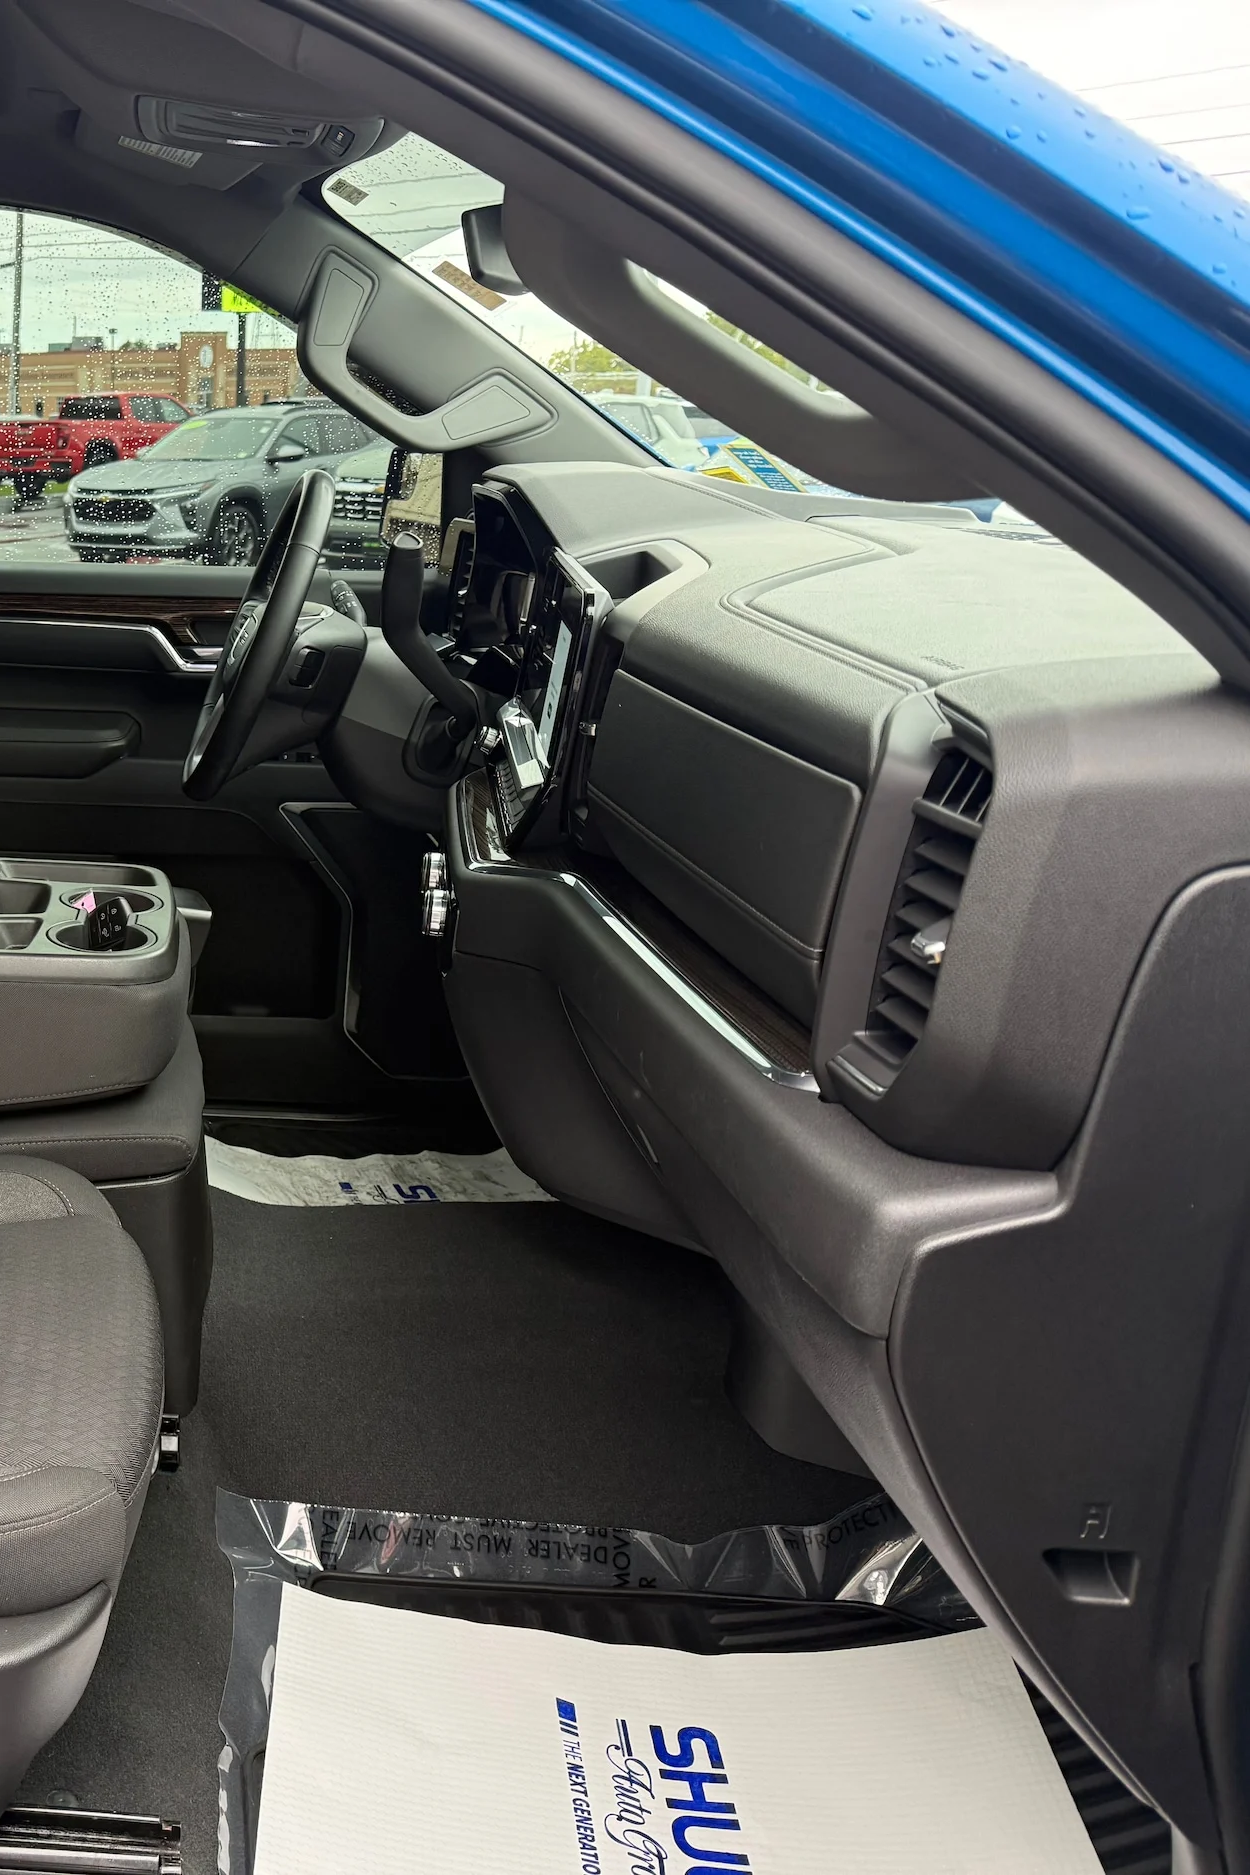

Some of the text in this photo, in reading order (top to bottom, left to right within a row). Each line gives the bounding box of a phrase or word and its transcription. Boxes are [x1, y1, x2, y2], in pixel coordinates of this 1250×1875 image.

[454, 1530, 512, 1554] MUST
[527, 1537, 608, 1565] DEALER
[563, 1739, 602, 1875] THE NEXT GENERATIO
[649, 1724, 755, 1875] SHU
